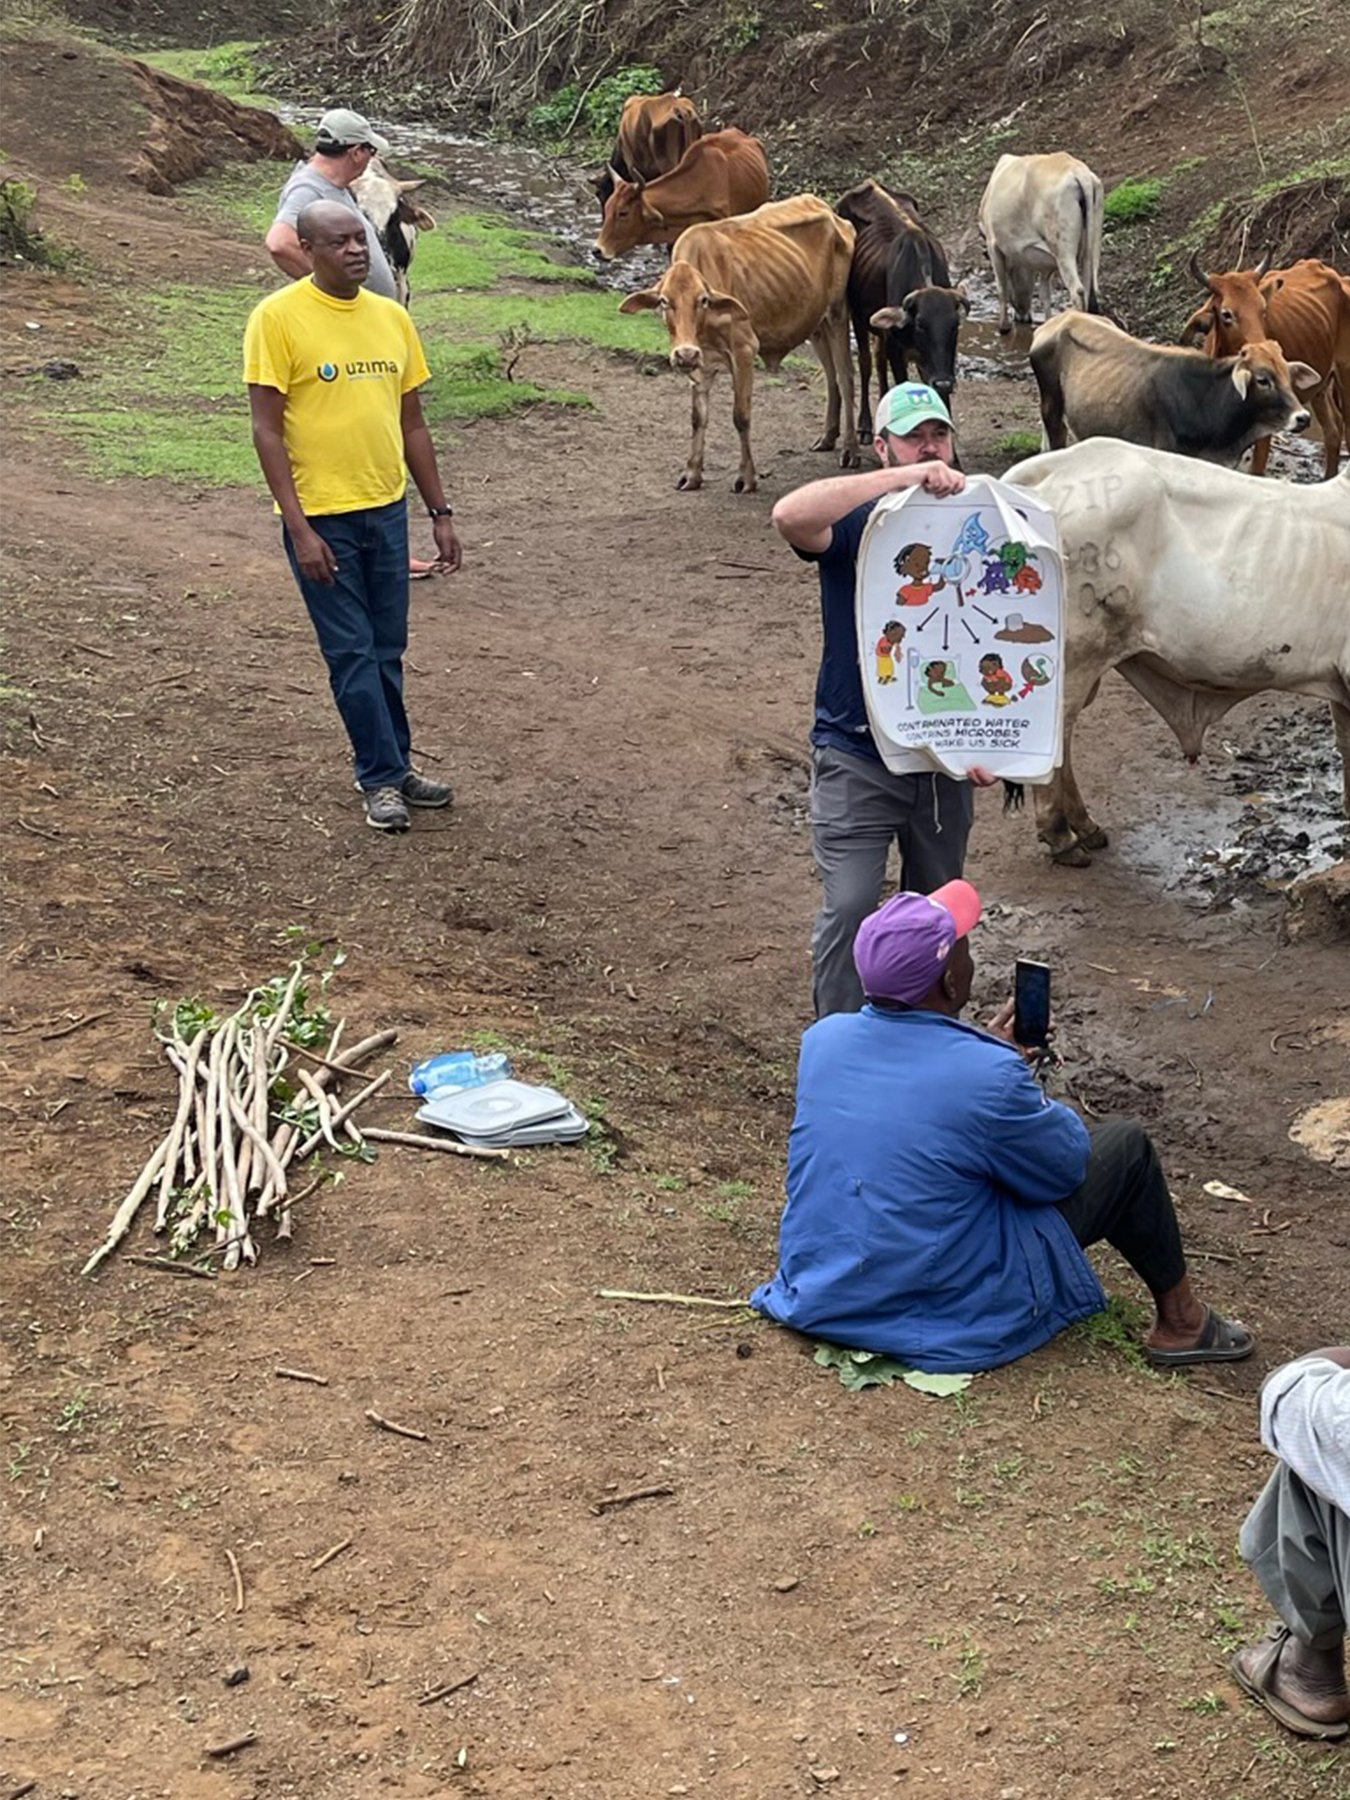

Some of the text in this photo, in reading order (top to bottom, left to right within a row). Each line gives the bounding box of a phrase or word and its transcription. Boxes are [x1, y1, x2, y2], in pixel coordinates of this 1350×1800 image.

[345, 360, 398, 376] uzima
[897, 718, 1030, 732] CONTAMINATED WATER
[954, 728, 1021, 738] MICROBES
[935, 739, 964, 748] MAKE
[969, 739, 986, 748] US
[990, 739, 1021, 748] SICK
